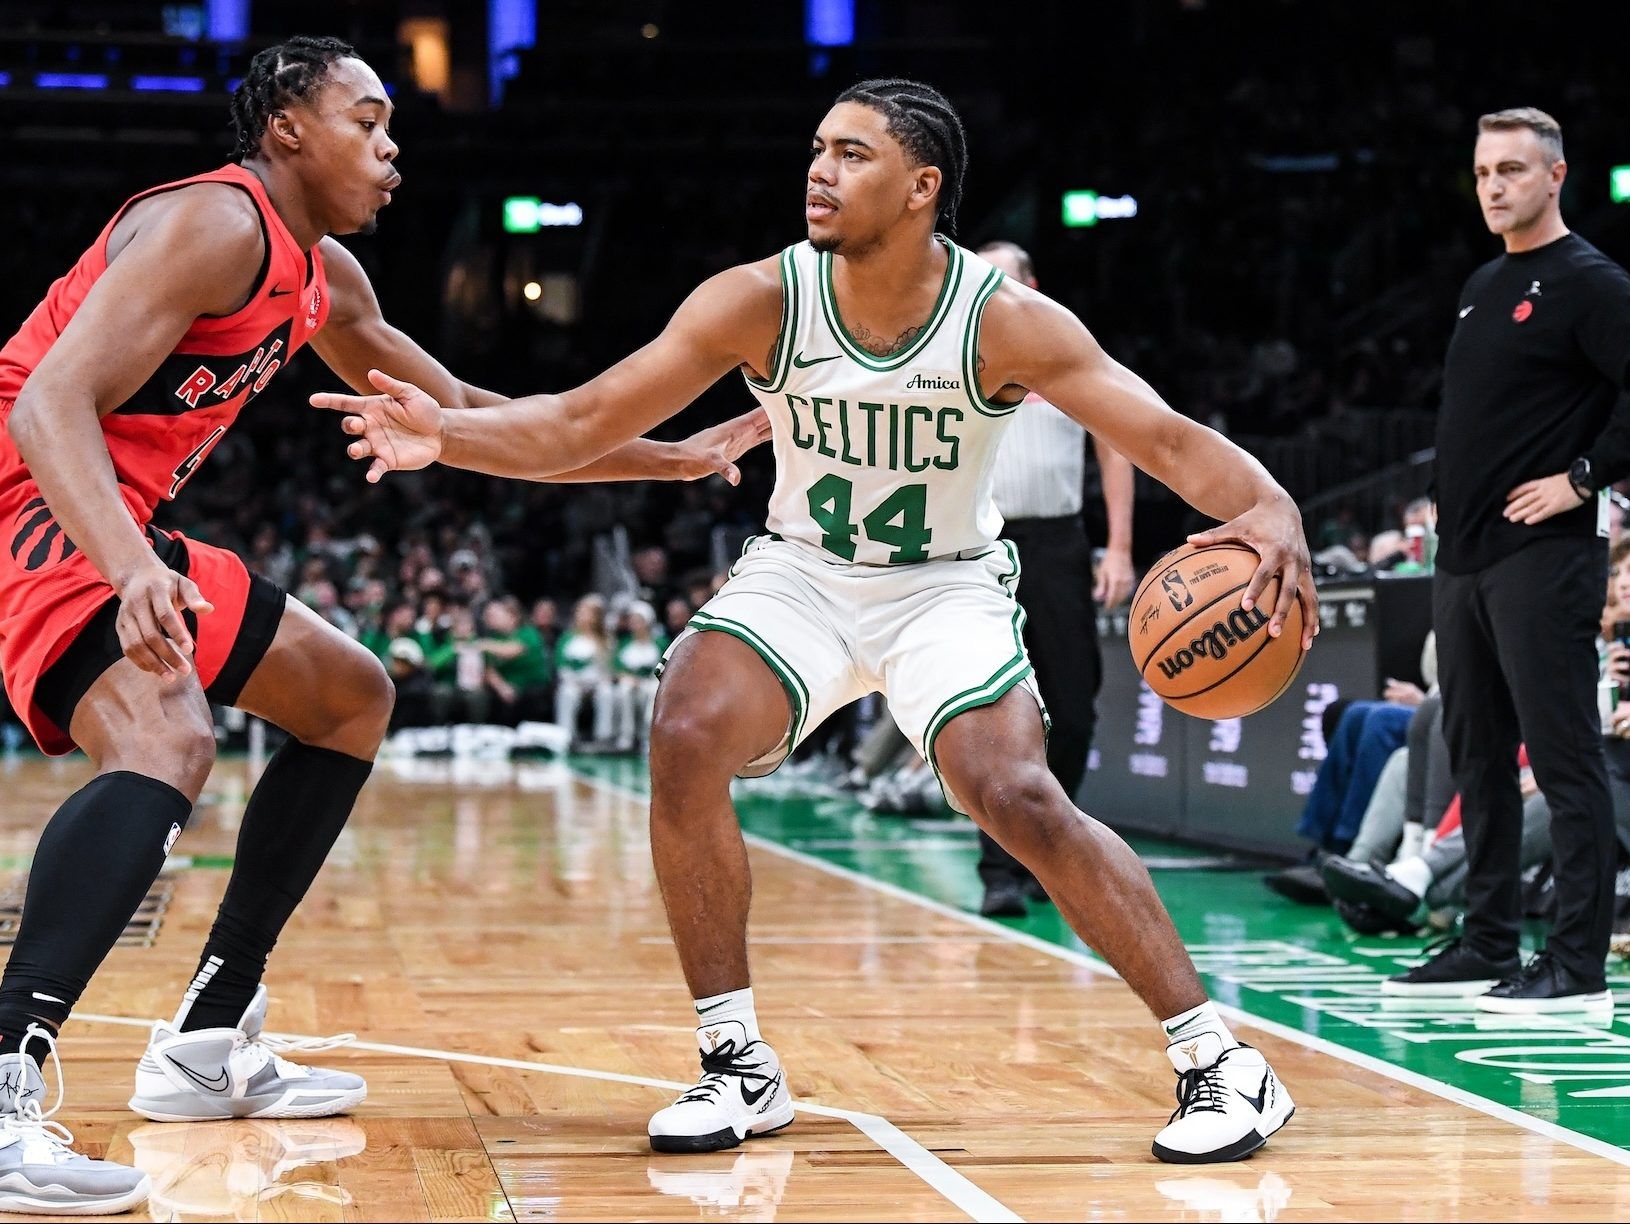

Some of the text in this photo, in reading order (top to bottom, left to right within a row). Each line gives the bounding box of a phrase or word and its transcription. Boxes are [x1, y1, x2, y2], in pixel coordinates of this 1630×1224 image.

[175, 338, 284, 409] RAPTO
[906, 373, 961, 390] Amica
[785, 393, 964, 473] CELTICS
[806, 472, 933, 564] 44
[1157, 604, 1271, 680] Wilson
